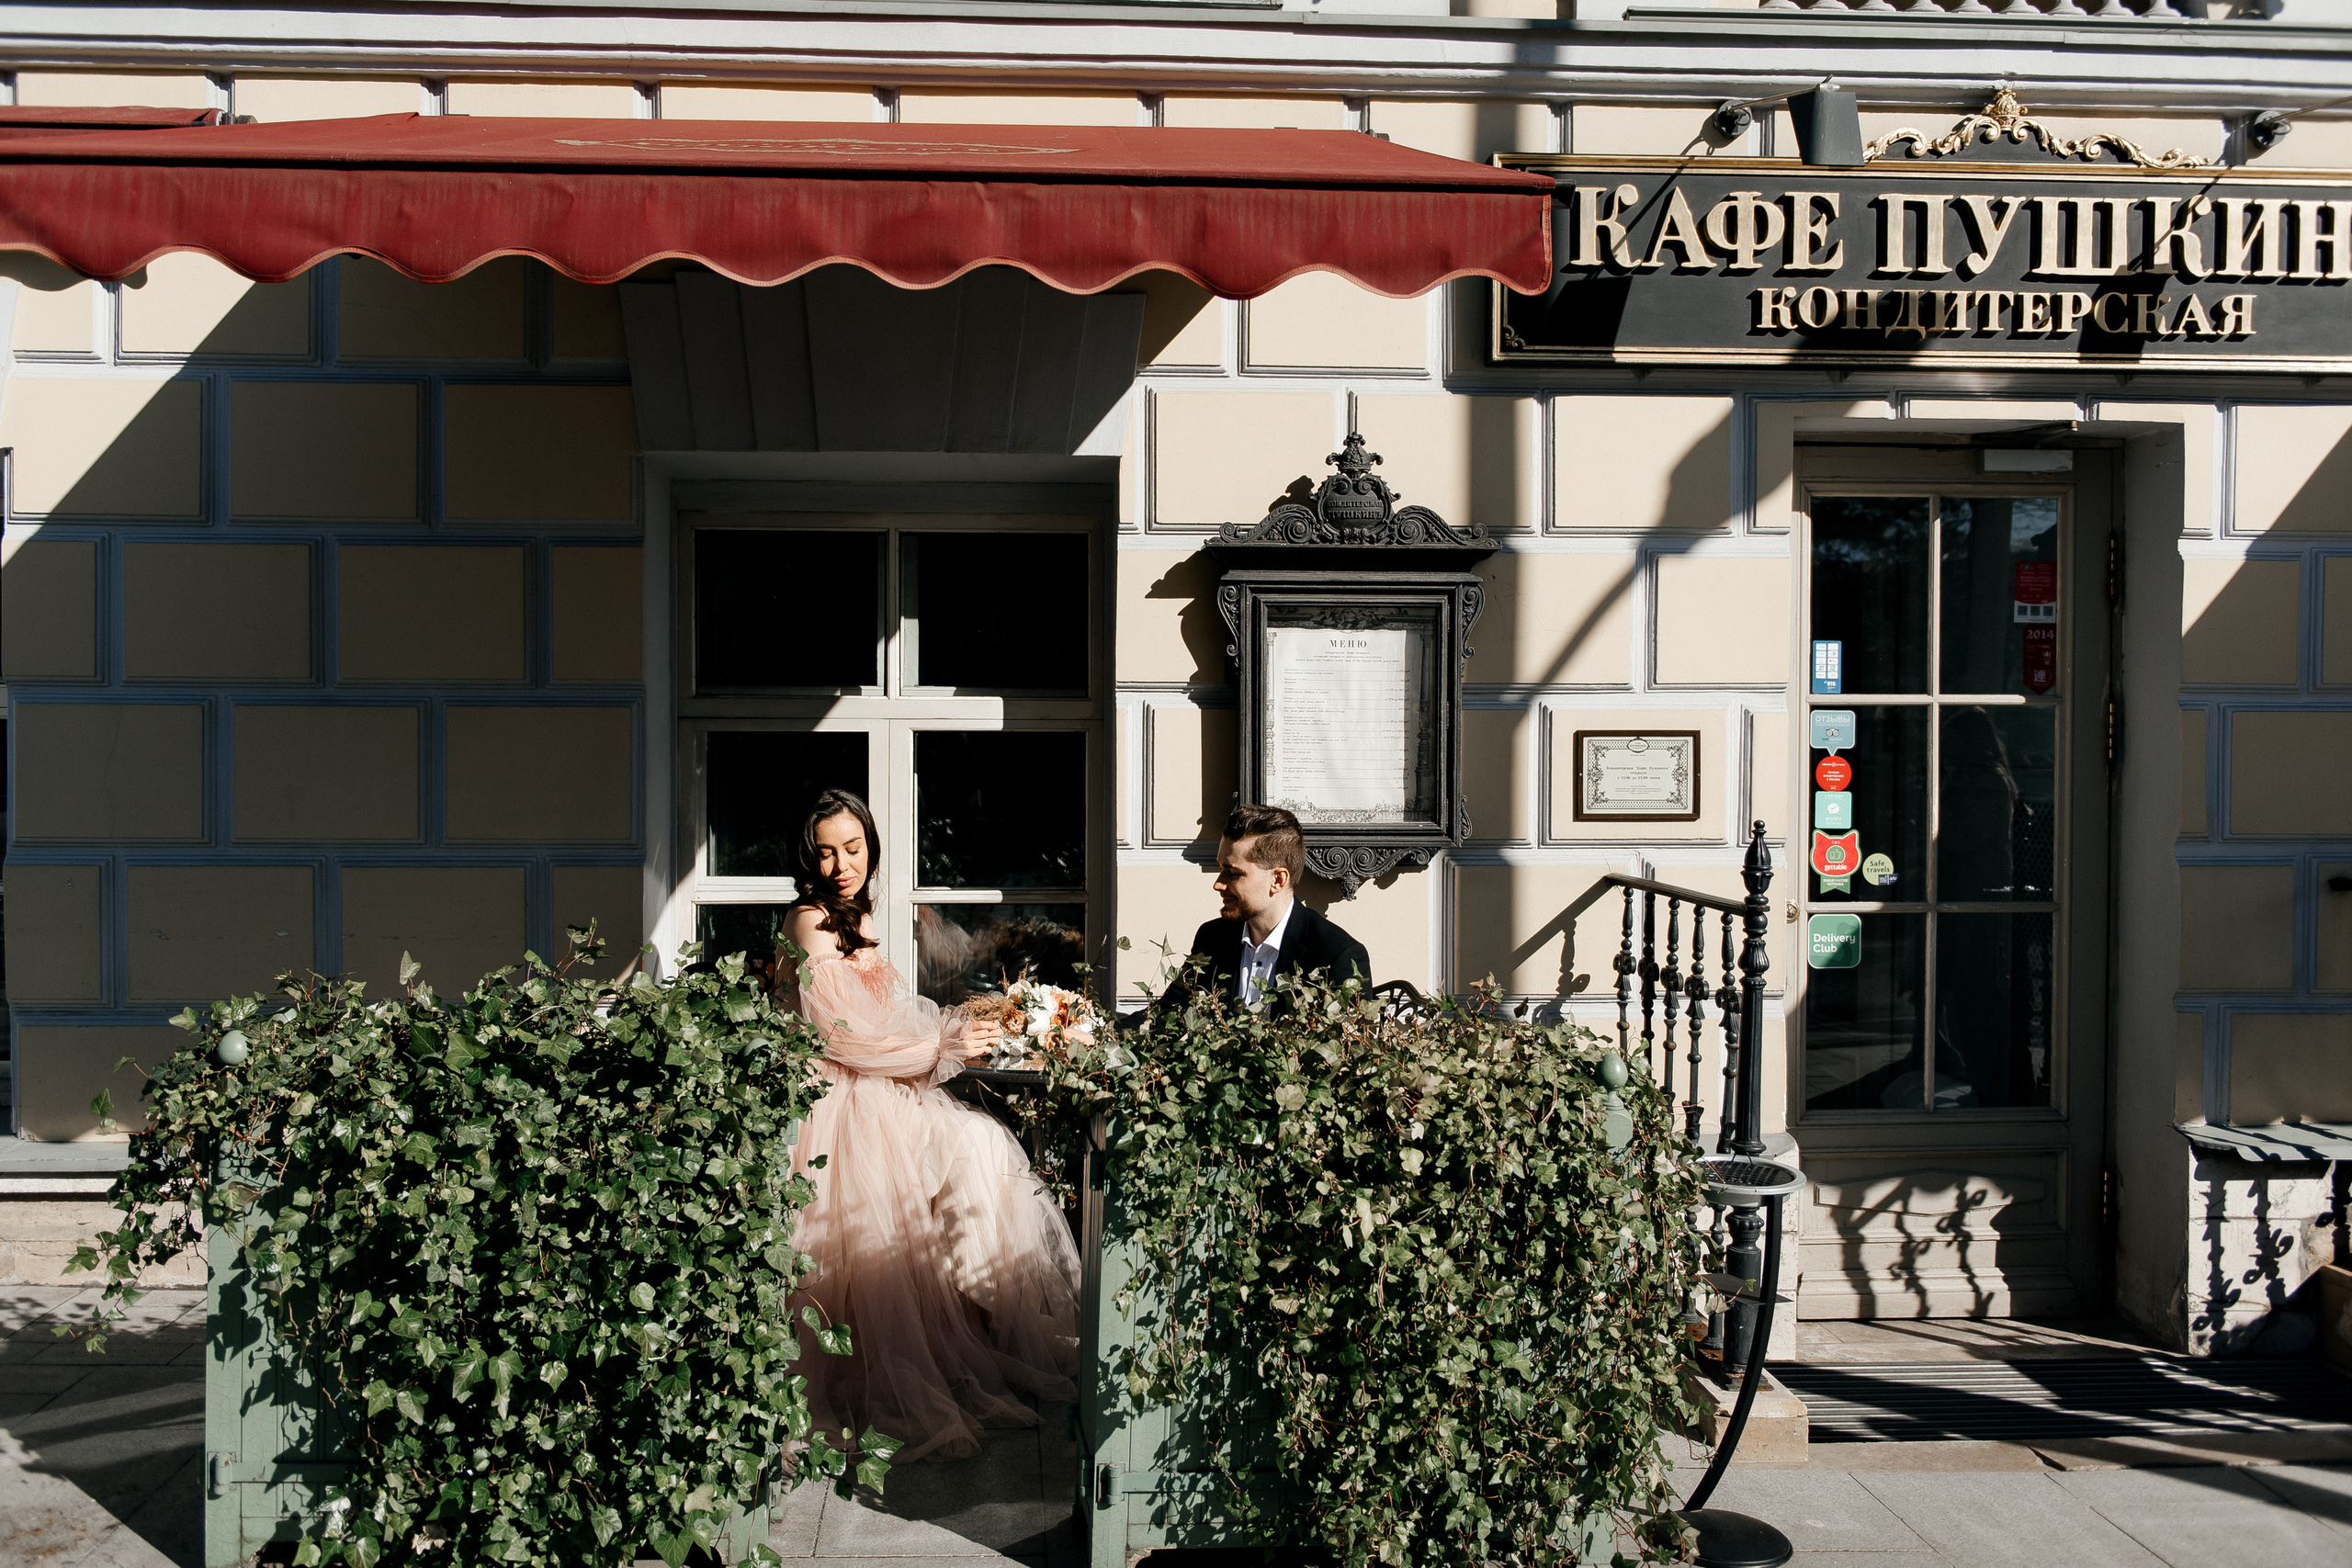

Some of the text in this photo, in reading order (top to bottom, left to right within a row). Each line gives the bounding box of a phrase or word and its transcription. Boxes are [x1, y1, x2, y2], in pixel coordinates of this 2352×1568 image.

[1570, 184, 1843, 269] КАФЕ
[1757, 287, 2257, 341] КОНДИТЕРСКАЯ
[2026, 629, 2054, 639] 2014
[1329, 639, 1367, 649] МЕНЮ
[1815, 716, 1850, 724] ОТЗЫВЫ
[1824, 863, 1848, 872] gettable
[1813, 933, 1856, 944] Delivery
[1813, 944, 1838, 953] Club
